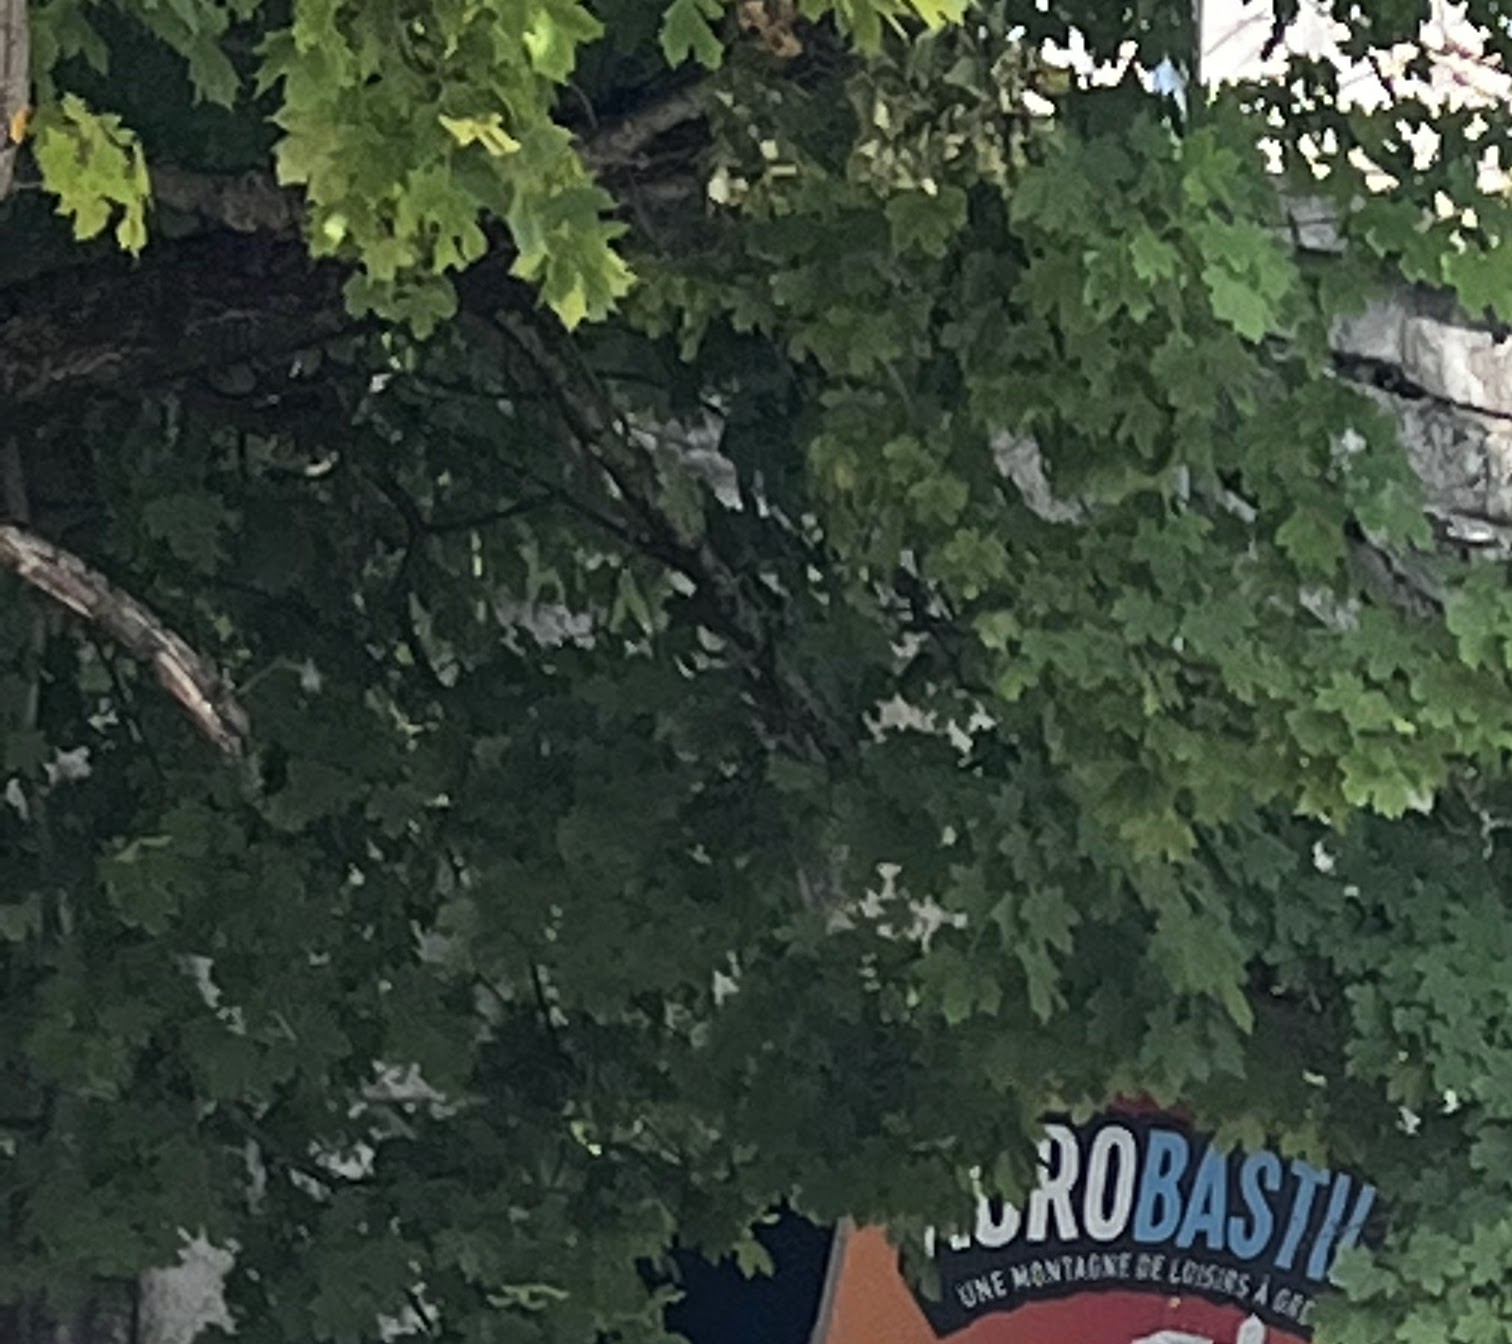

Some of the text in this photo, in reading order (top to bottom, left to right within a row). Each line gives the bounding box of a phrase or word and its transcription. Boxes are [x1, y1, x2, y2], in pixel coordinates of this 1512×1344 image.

[956, 1269, 1008, 1308] UNE
[1011, 1252, 1132, 1290] MONTAGNE
[1135, 1252, 1166, 1282] DE
[1168, 1256, 1250, 1300] LOISIRS
